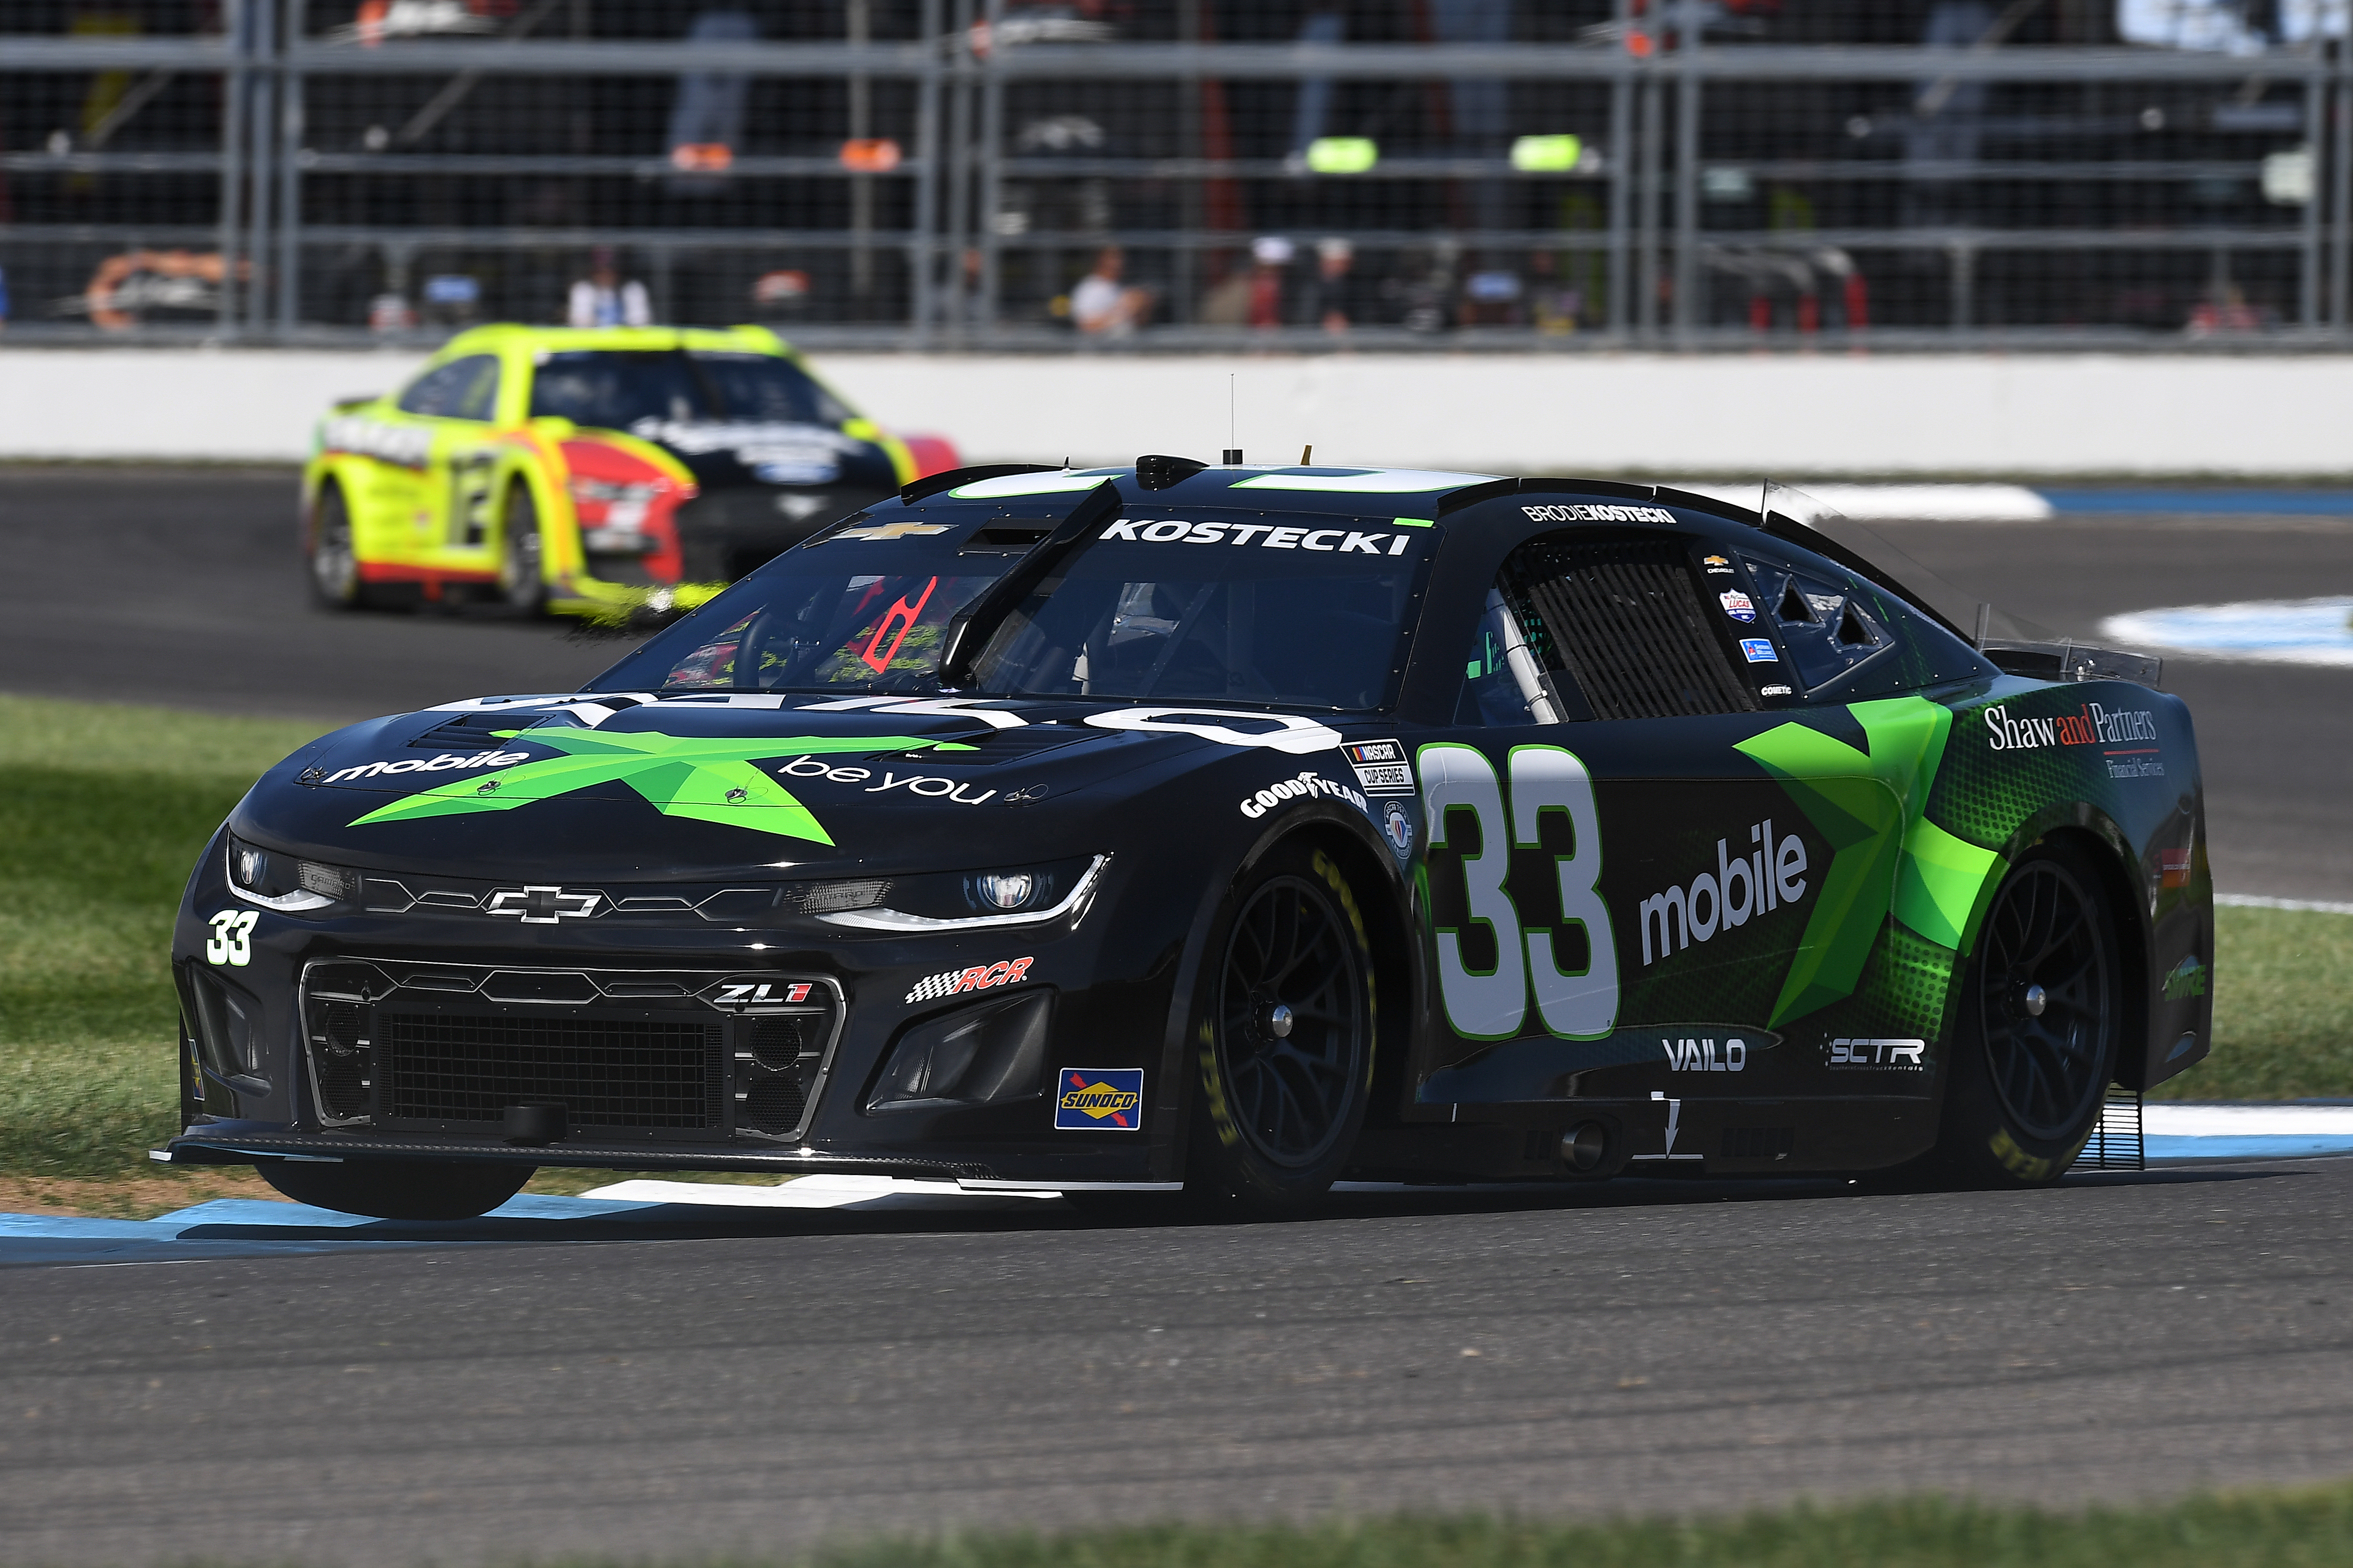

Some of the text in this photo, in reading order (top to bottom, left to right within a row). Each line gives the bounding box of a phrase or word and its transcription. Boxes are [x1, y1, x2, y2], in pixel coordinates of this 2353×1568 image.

[1098, 519, 1411, 556] KOSTECKI
[1729, 599, 1750, 608] LUCAS
[1984, 702, 2157, 750] Shaw and Partners
[322, 750, 530, 783] mobile
[1361, 744, 1396, 760] NASCAR
[777, 755, 997, 804] be you
[1364, 768, 1404, 784] CUP SERIES
[1240, 776, 1369, 819] GOODYEAR
[1416, 742, 1621, 1041] 33
[1640, 818, 1808, 966] mobile
[207, 909, 260, 966] 33
[713, 983, 813, 1003] ZL1
[951, 957, 1034, 994] RCR
[1661, 1039, 1746, 1071] VAILO
[1831, 1038, 1925, 1064] SCTR
[1064, 1094, 1135, 1108] SUNOCO
